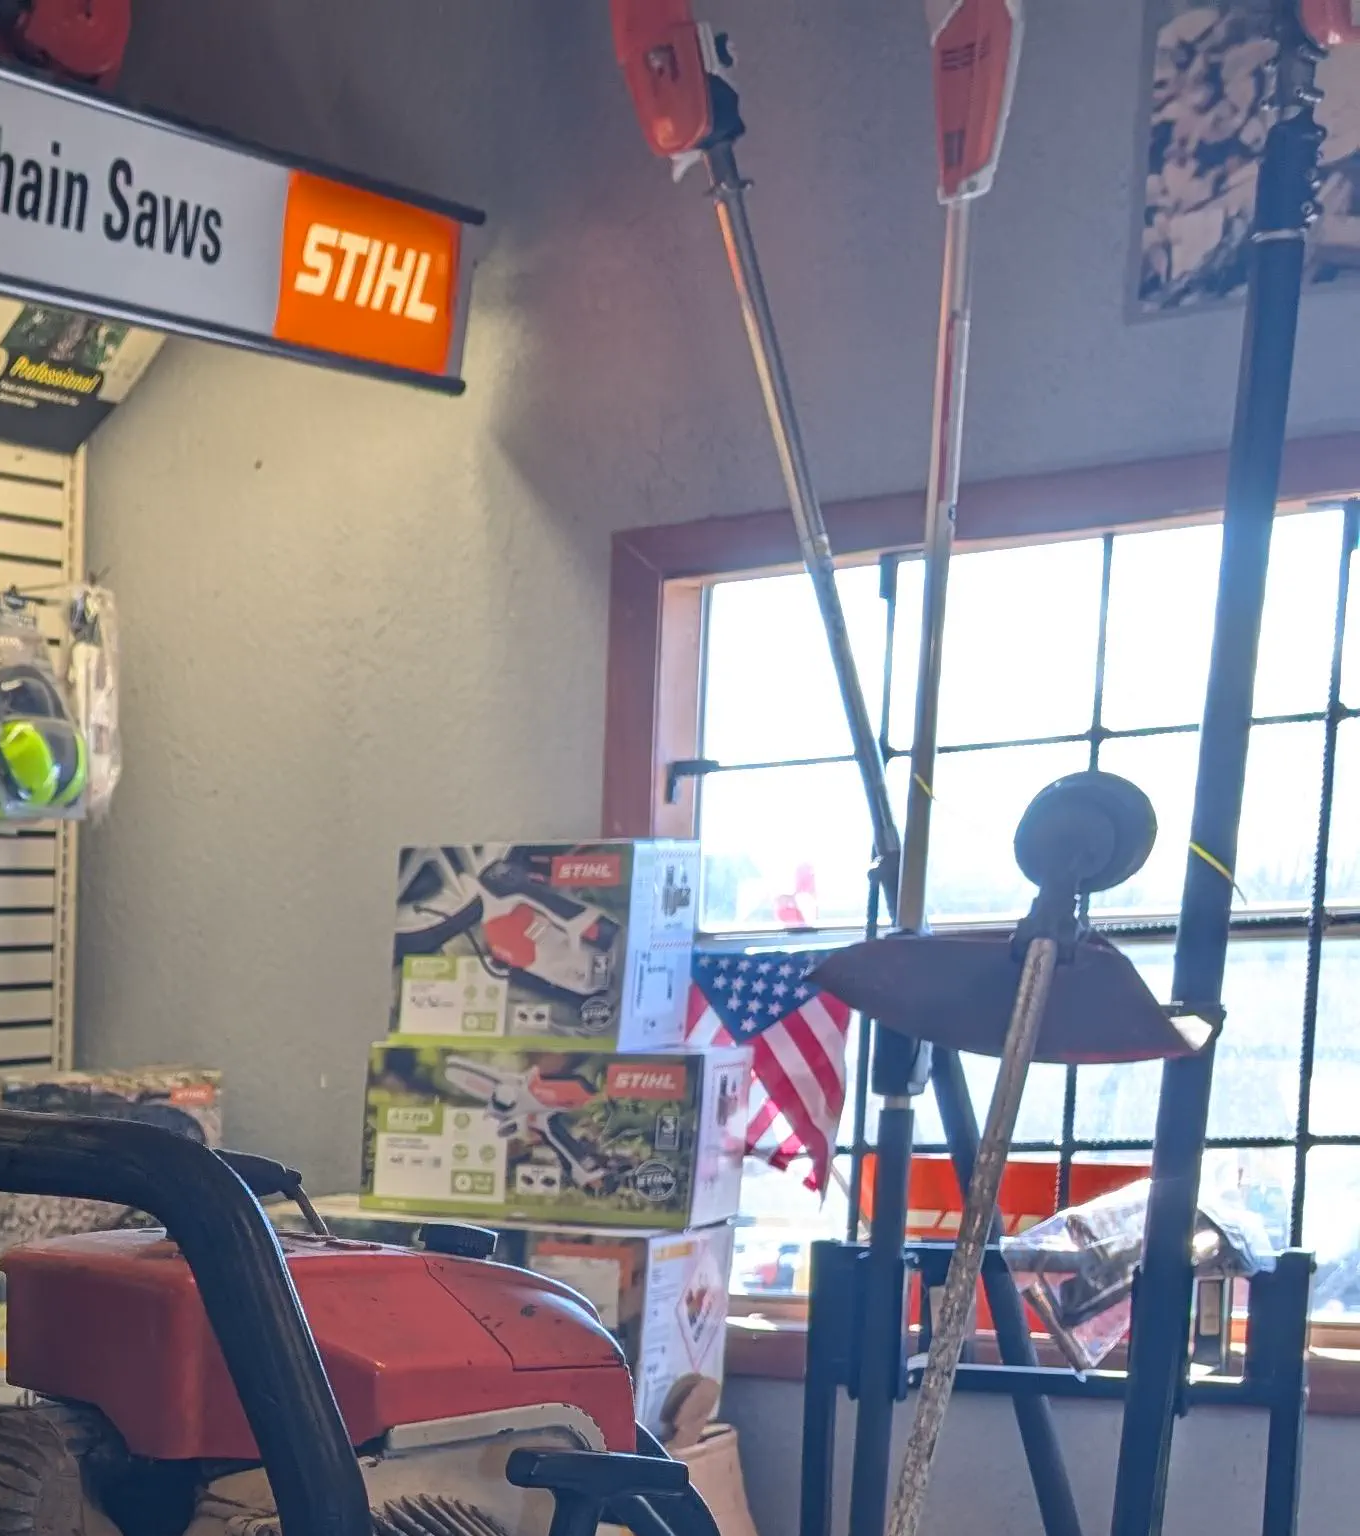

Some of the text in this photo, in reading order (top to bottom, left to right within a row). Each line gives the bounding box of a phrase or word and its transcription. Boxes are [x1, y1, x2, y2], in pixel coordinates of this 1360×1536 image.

[103, 157, 223, 266] Saws
[295, 223, 438, 324] STIHL
[9, 354, 102, 394] Professional
[558, 863, 612, 879] STIHL
[614, 1071, 677, 1090] STIHL
